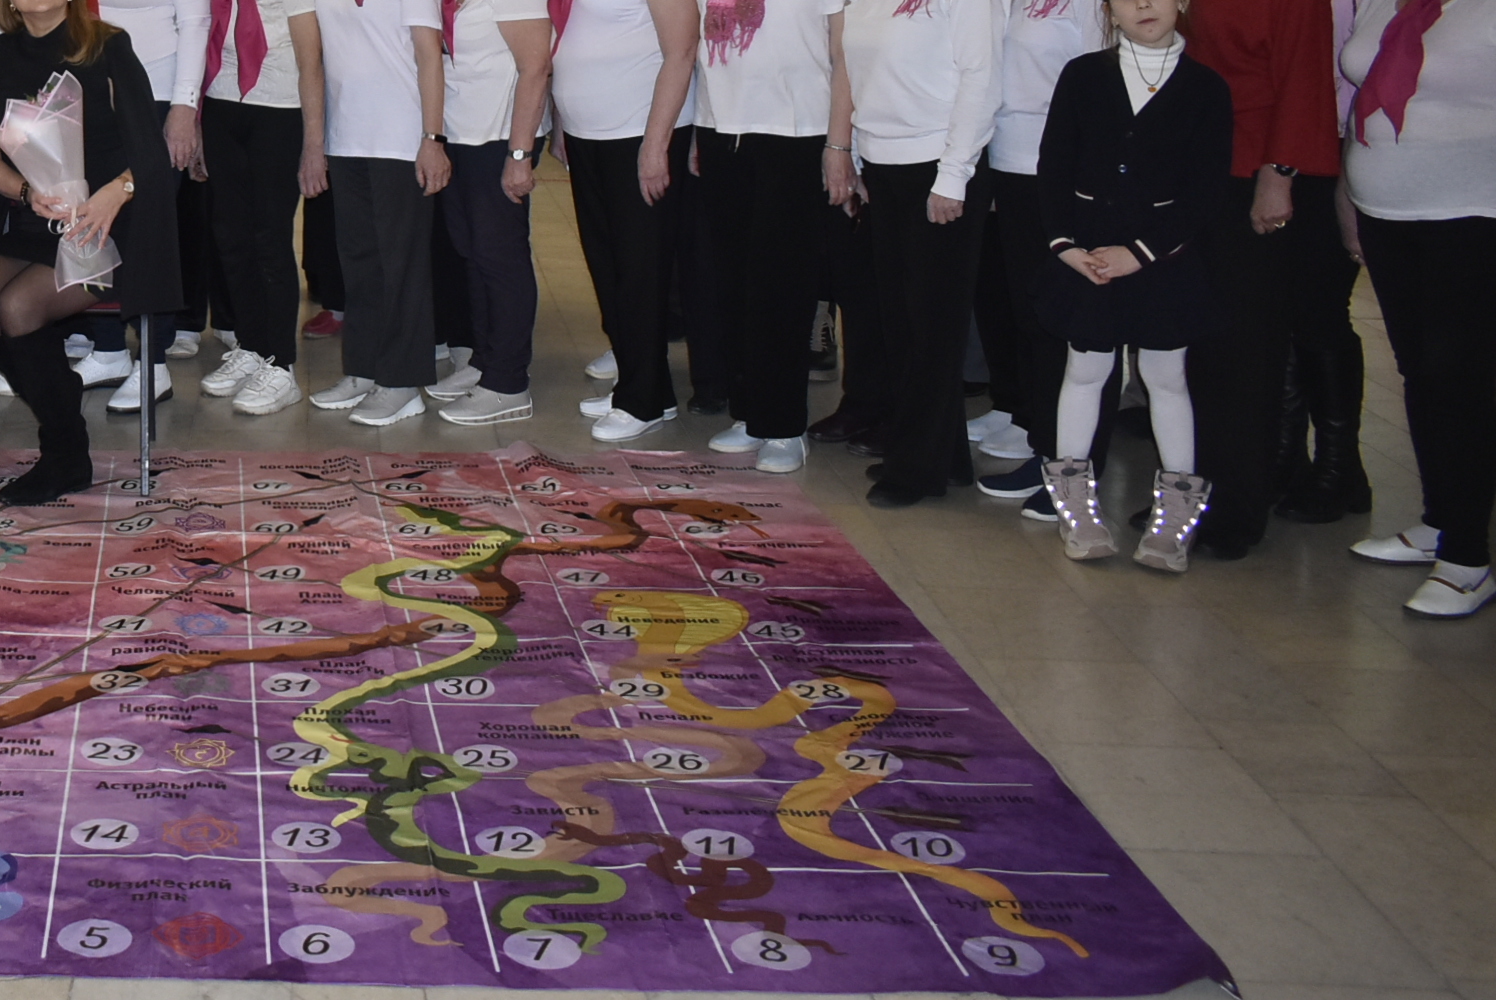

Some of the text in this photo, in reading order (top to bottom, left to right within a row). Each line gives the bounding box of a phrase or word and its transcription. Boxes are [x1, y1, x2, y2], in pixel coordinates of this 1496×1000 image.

[115, 518, 153, 531] 59
[398, 525, 431, 535] 61
[110, 566, 152, 578] 50
[259, 568, 302, 579] 49
[409, 569, 452, 582] 48
[562, 572, 601, 583] 47
[717, 570, 760, 584] 46
[104, 620, 146, 631] 41
[263, 621, 308, 633] 42
[617, 616, 720, 624] Неведение
[586, 623, 636, 637] 44
[753, 624, 800, 638] 45
[318, 660, 367, 669] План
[95, 674, 143, 690] 32
[269, 678, 312, 693] 31
[440, 678, 489, 695] 30
[617, 682, 665, 698] 29
[794, 683, 845, 700] 28
[118, 701, 219, 714] Небесный
[304, 706, 377, 716] Плохая
[292, 715, 392, 725] компания
[639, 712, 713, 722] Печаль
[479, 722, 572, 732] Хорошая
[477, 731, 581, 740] компания
[86, 741, 139, 760] 23
[272, 747, 325, 764] 24
[461, 749, 511, 768] 25
[651, 753, 704, 771] 26
[844, 754, 889, 772] 27
[95, 780, 227, 791] Астральный
[136, 790, 188, 800] план
[510, 804, 599, 817] Зависть
[79, 824, 130, 843] 14
[281, 827, 331, 847] 13
[486, 831, 535, 853] 12
[694, 835, 736, 856] 11
[900, 837, 954, 858] 10
[87, 876, 233, 892] Физический
[286, 882, 451, 898] Заблуждение
[131, 892, 188, 902] план
[547, 909, 684, 923] Тщеславие
[79, 926, 111, 950] 5
[302, 932, 332, 956] 6
[526, 937, 554, 961] 7
[758, 937, 788, 963] 8
[988, 944, 1018, 967] 9
